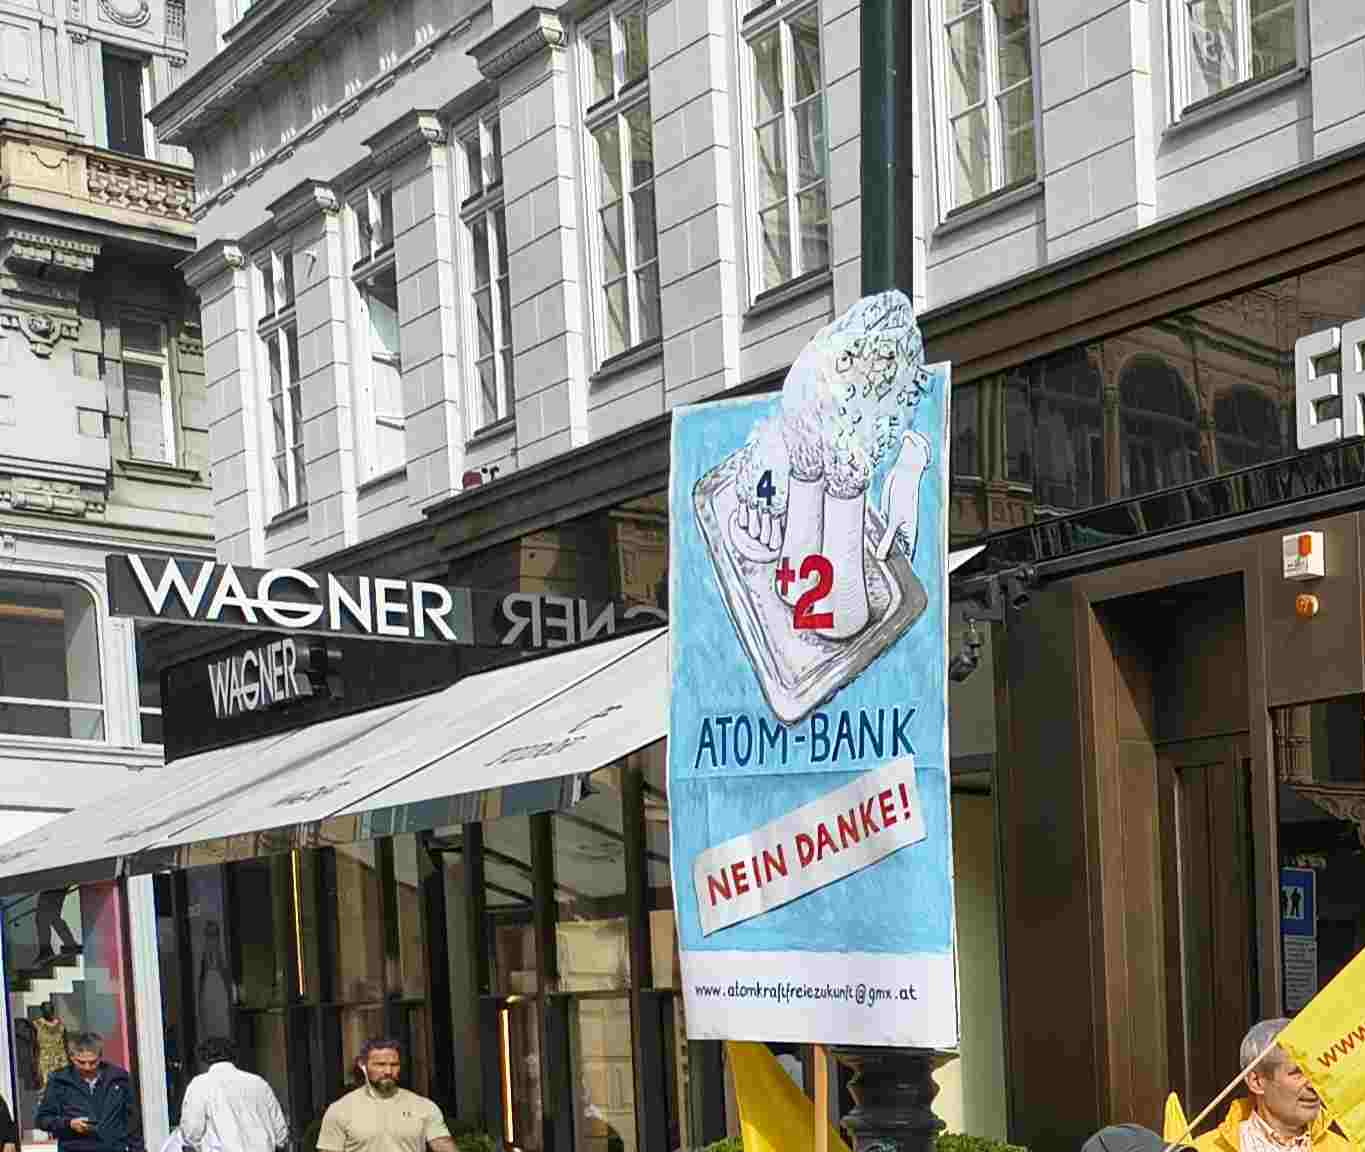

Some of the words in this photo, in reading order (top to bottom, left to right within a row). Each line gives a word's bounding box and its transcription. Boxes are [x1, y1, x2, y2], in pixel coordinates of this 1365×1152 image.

[757, 470, 776, 506] 4
[128, 553, 457, 641] WAGNER
[207, 638, 300, 719] WAGNER
[695, 707, 916, 769] ATOM-BANK
[705, 843, 790, 906] NEIN
[794, 782, 912, 869] DANKE!
